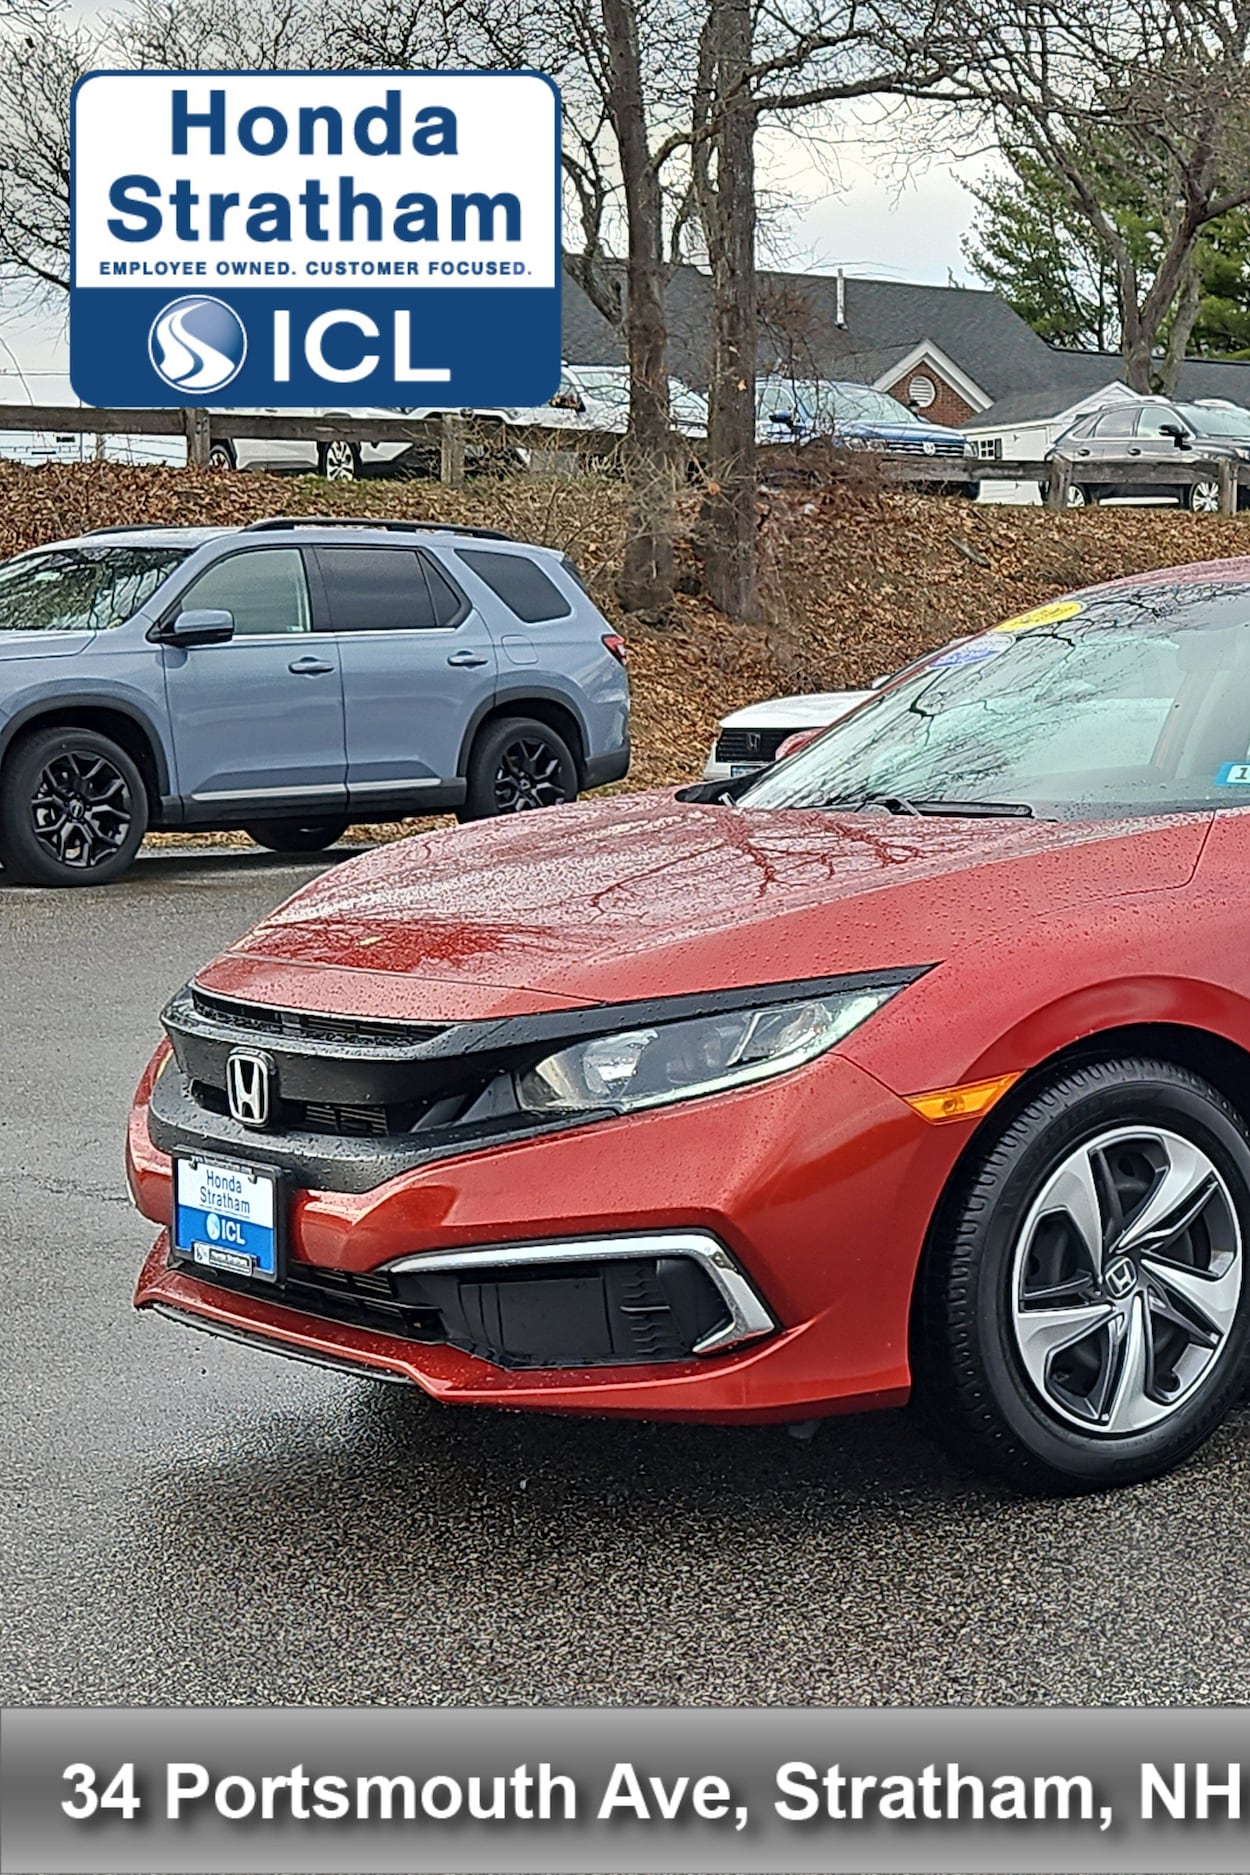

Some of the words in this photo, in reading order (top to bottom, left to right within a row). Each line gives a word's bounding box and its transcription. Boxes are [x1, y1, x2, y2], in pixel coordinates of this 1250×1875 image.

[206, 1169, 242, 1193] Honda
[199, 1186, 251, 1214] Stratham
[221, 1218, 246, 1245] ICL
